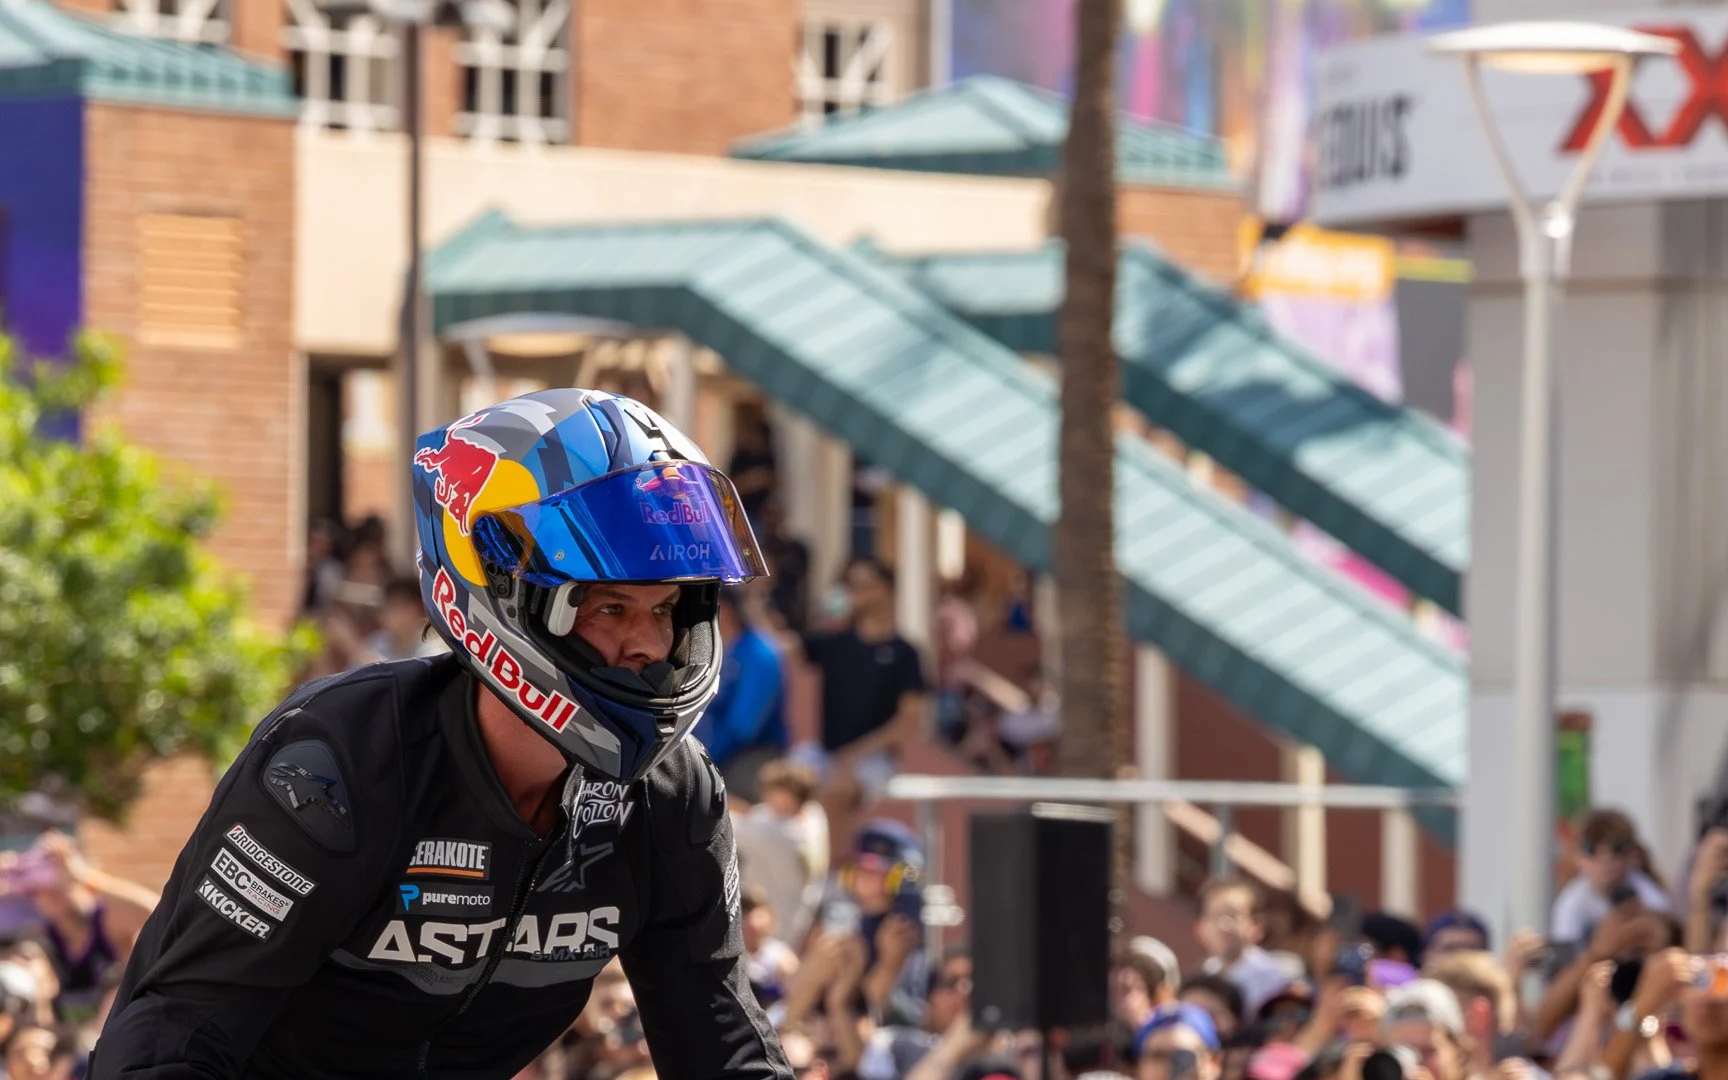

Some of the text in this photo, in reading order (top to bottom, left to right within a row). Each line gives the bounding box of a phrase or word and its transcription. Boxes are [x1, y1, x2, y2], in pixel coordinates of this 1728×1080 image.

[650, 544, 710, 561] AIROH
[432, 567, 579, 734] Red Bull
[214, 852, 251, 890] EBC
[227, 826, 314, 894] BRIDGESTONE
[245, 888, 281, 915] RACING
[422, 892, 490, 906] puremoto
